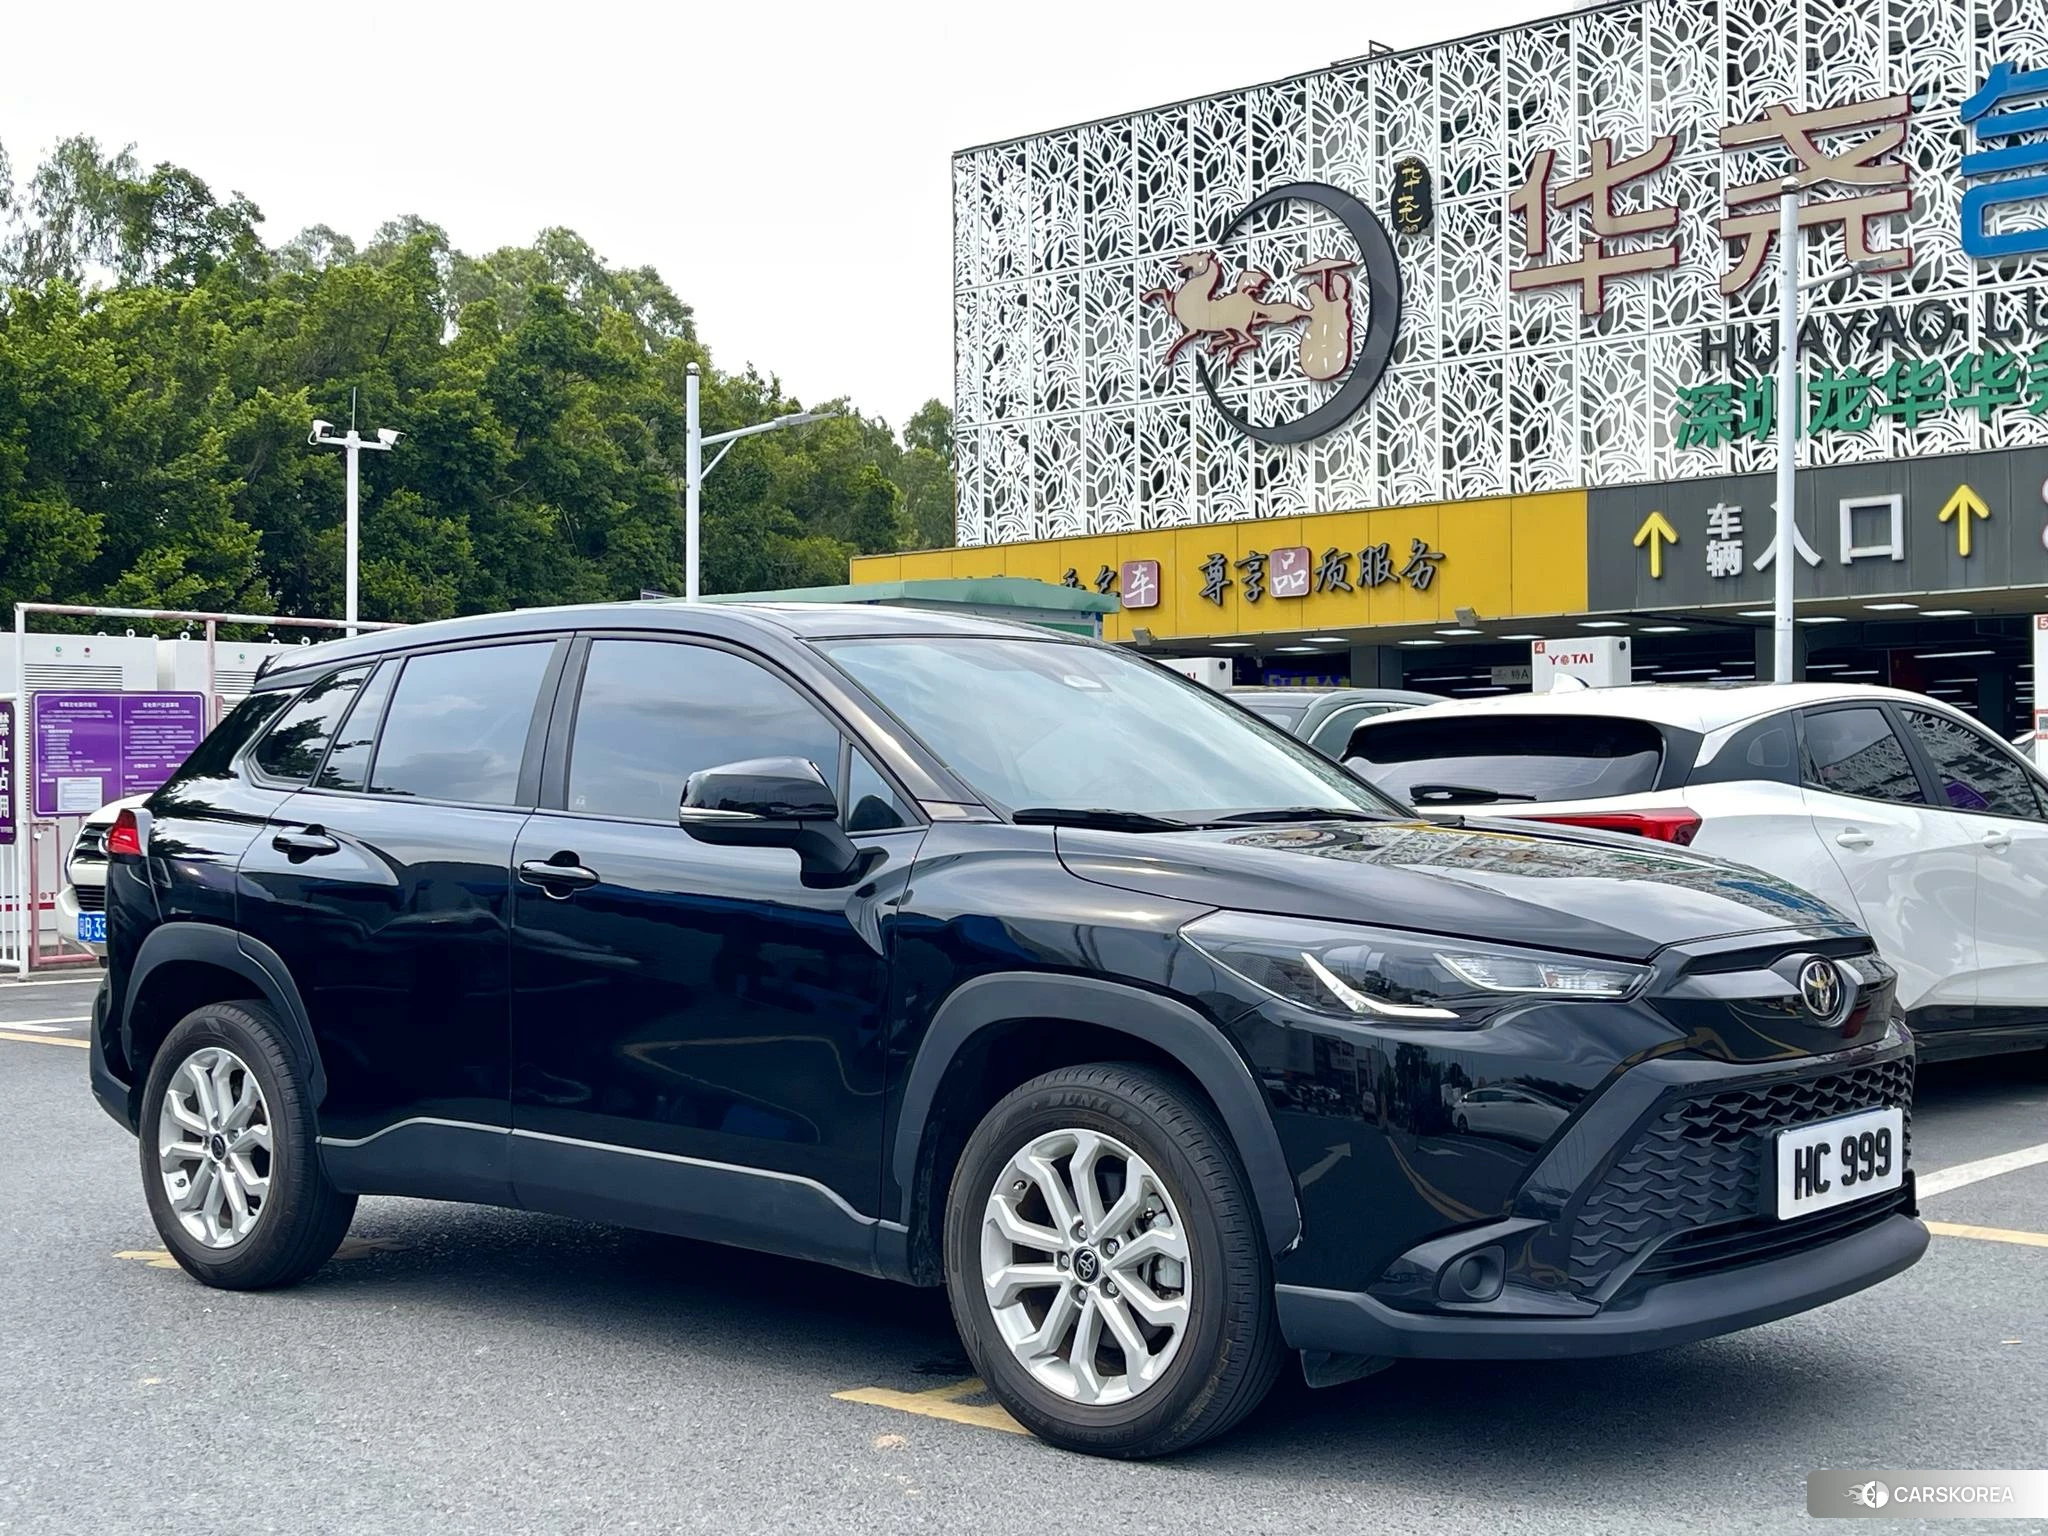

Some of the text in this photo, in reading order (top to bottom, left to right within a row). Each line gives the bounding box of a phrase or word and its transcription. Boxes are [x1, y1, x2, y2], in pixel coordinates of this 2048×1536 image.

[1700, 299, 1953, 372] HUAYAO
[1197, 538, 1445, 606] 尊享品质服务
[1705, 502, 1744, 578] 车辆
[1794, 1127, 1892, 1201] HC 999
